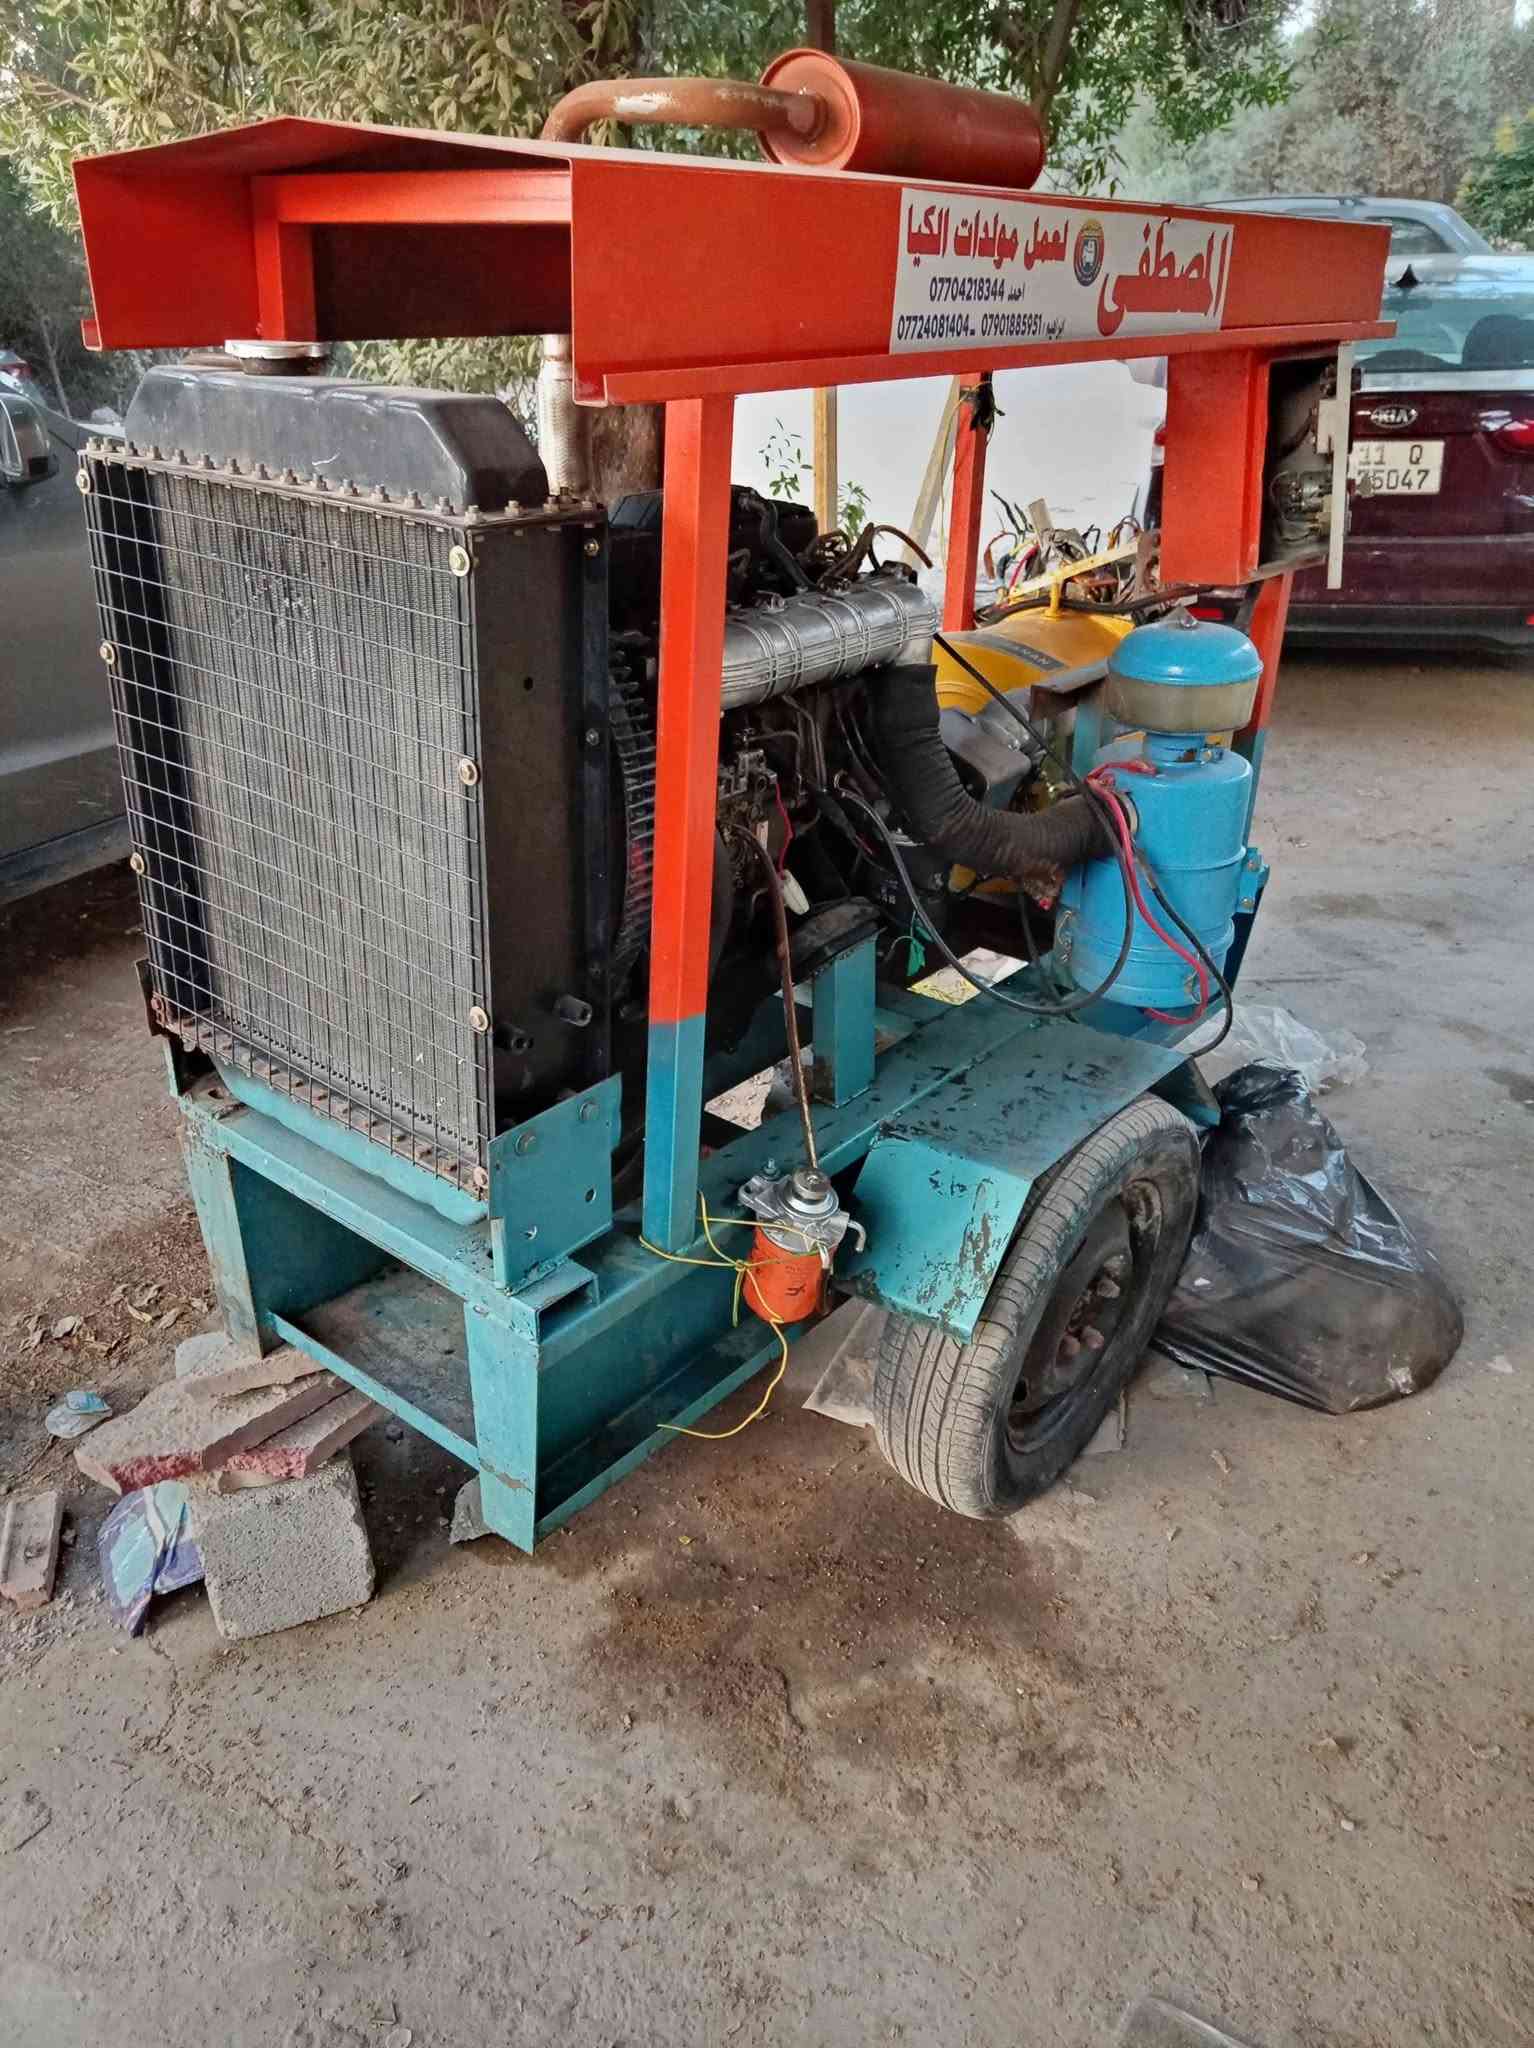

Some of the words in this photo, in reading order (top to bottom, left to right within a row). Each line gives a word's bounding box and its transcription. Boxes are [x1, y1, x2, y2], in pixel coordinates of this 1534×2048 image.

[907, 203, 950, 269] الكيا
[954, 209, 1019, 270] مولدات
[1024, 216, 1069, 271] لعمل
[929, 277, 1005, 302] 07704218344
[1097, 218, 1229, 337] المصطفى
[897, 314, 969, 340] 07724081404
[981, 313, 1043, 337] 07901885951
[1376, 408, 1409, 423] KIA
[1409, 444, 1424, 465] Q
